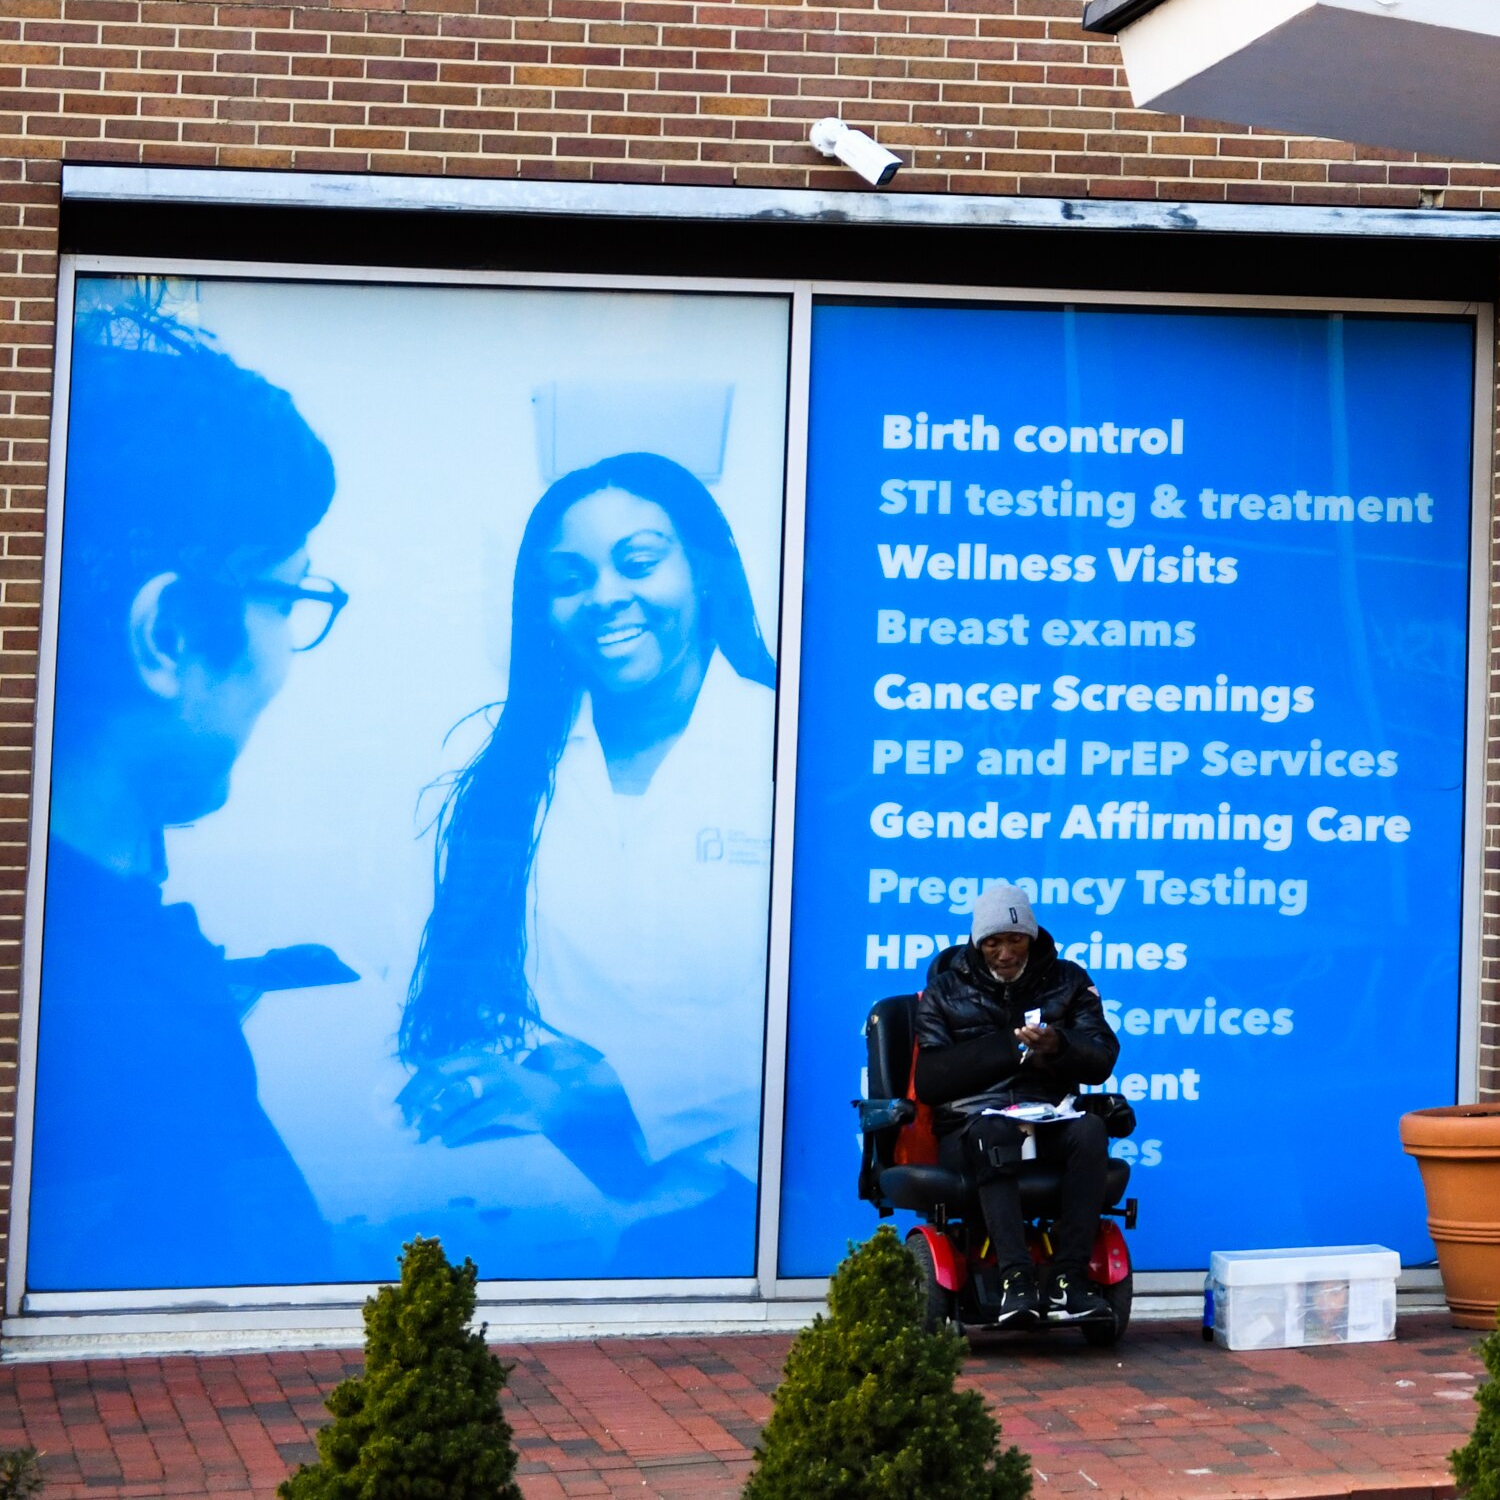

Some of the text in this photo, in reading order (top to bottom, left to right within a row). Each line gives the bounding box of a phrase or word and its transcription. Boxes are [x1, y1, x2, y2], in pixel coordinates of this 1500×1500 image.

[882, 412, 1184, 457] Birth control
[878, 480, 1434, 529] STI testing & treatment
[878, 543, 1239, 585] Wellness Visits
[877, 609, 1197, 648] Breast exams
[873, 673, 1316, 723] Cancer Screenings
[871, 739, 1399, 778] PEP and PrEP Services
[869, 803, 1412, 851] Gender Affirming Care
[1136, 866, 1309, 917] Testing
